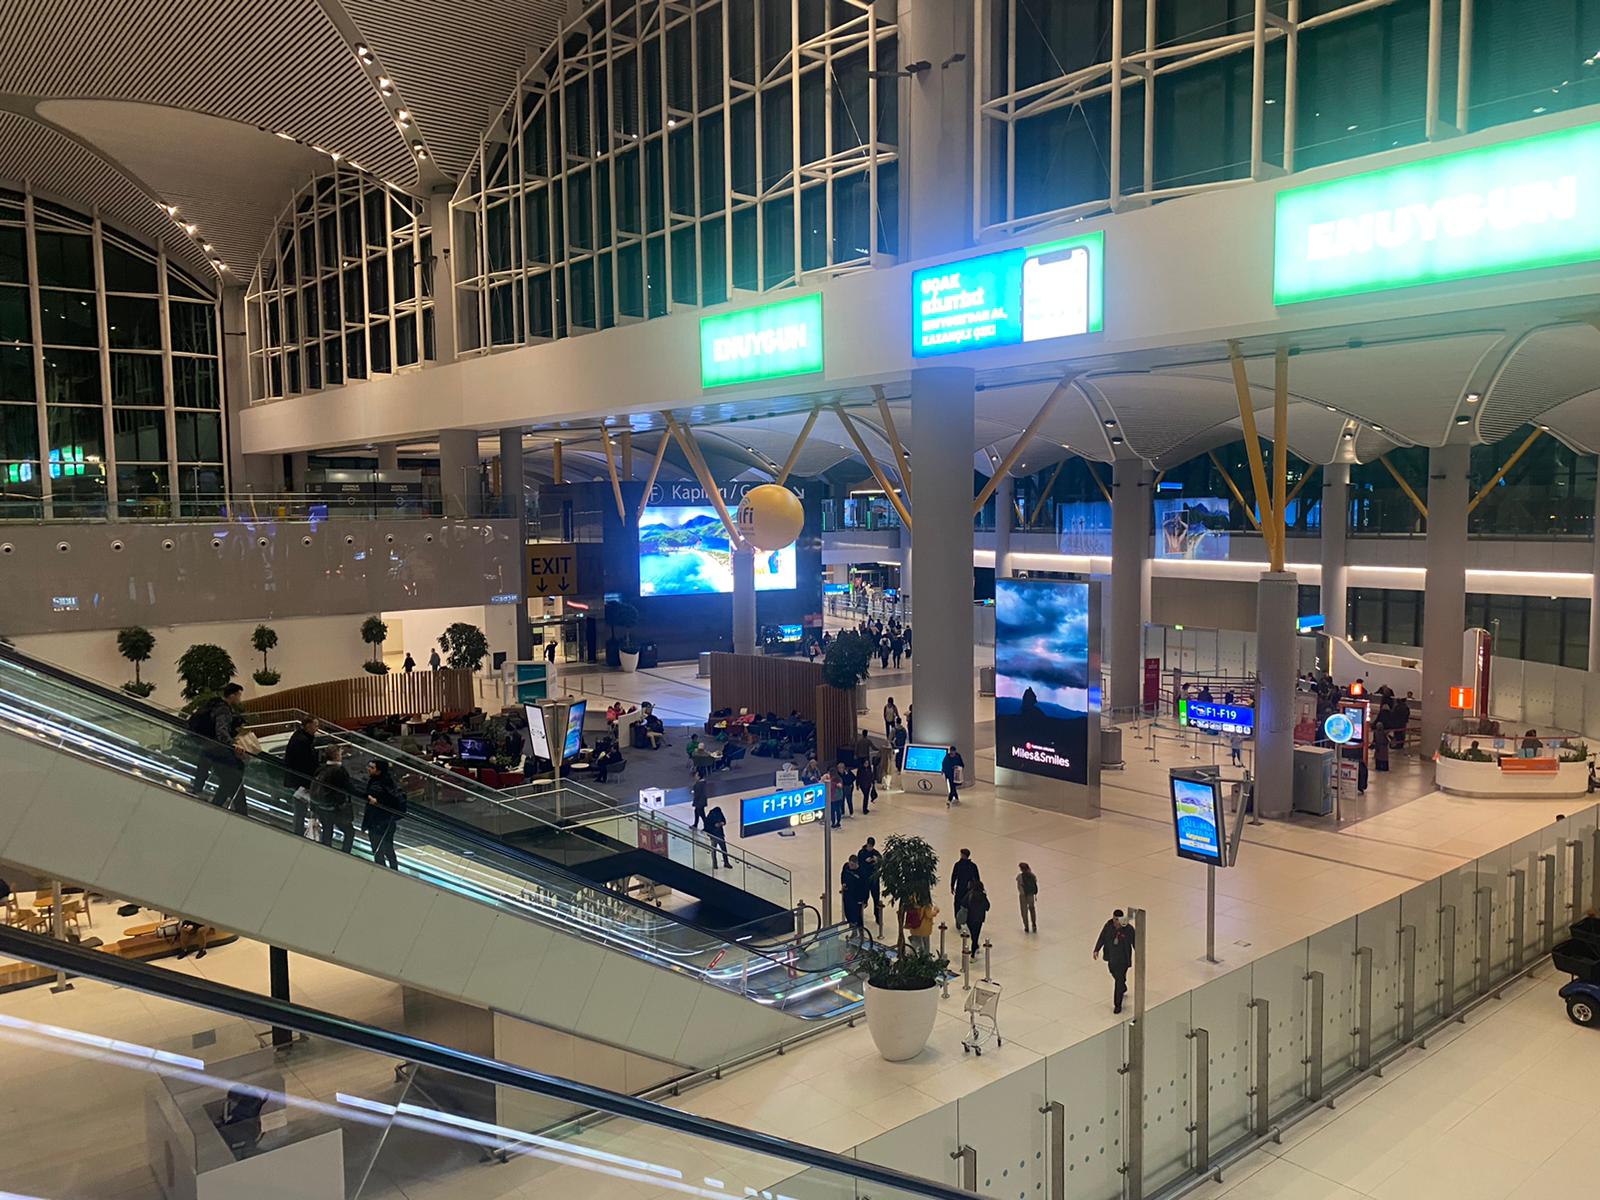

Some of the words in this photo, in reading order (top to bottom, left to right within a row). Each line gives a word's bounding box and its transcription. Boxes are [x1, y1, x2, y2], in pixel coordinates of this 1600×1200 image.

[531, 557, 572, 576] EXIT
[1206, 707, 1237, 720] F1-F19
[1011, 746, 1070, 767] Miles&Smiles
[763, 793, 802, 813] F1-F19
